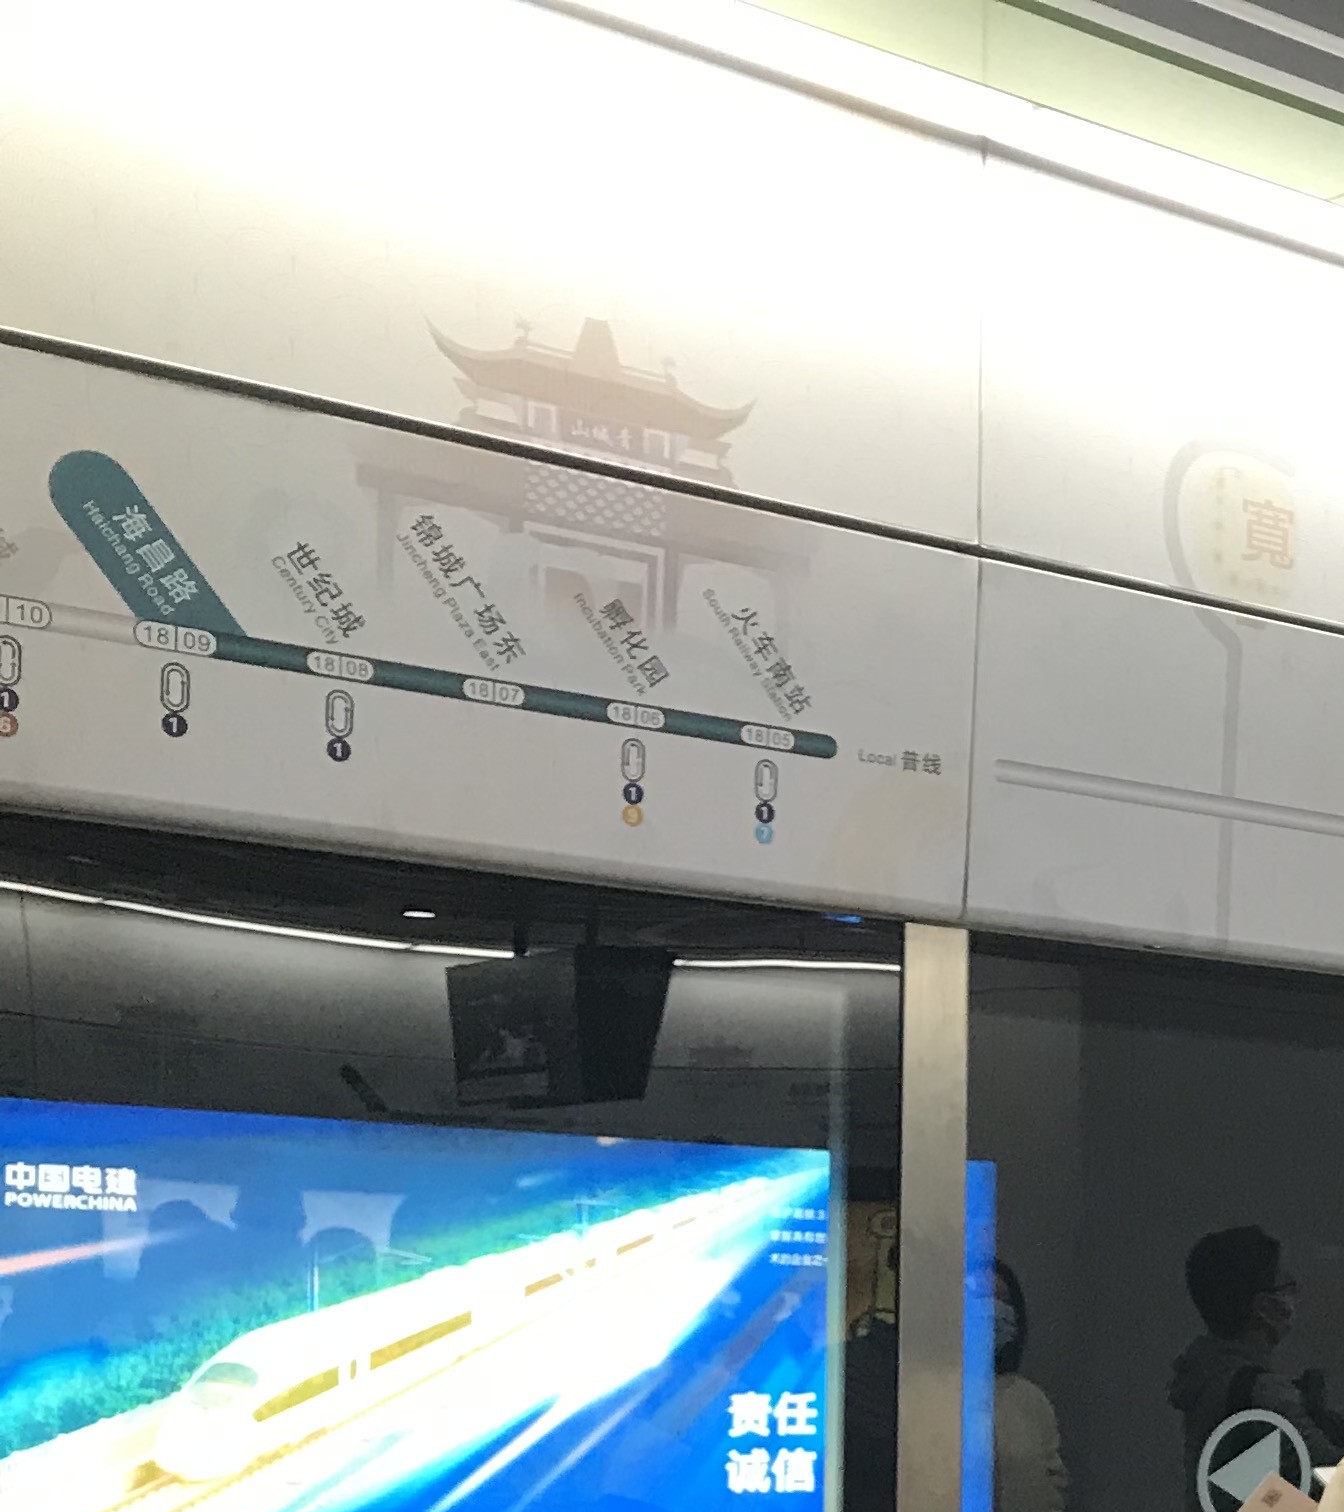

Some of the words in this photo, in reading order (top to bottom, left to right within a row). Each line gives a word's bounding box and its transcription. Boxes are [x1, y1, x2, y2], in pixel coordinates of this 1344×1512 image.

[82, 500, 140, 575] Haichang
[137, 573, 175, 616] Road
[112, 505, 199, 604] 海昌路
[287, 542, 365, 638] 世纪城
[396, 533, 448, 598] Jincheng
[442, 597, 475, 639] Plaza
[410, 515, 526, 663] 锦城广场东
[271, 555, 316, 614] Century
[314, 615, 340, 645] City
[573, 592, 624, 665] Incubation
[731, 606, 812, 716] 火车南站
[857, 749, 898, 767] Local
[5, 1162, 137, 1195] 中国电建
[5, 1192, 138, 1212] POWERCHINA
[728, 1391, 818, 1438] 责任
[725, 1447, 817, 1494] 诚信
